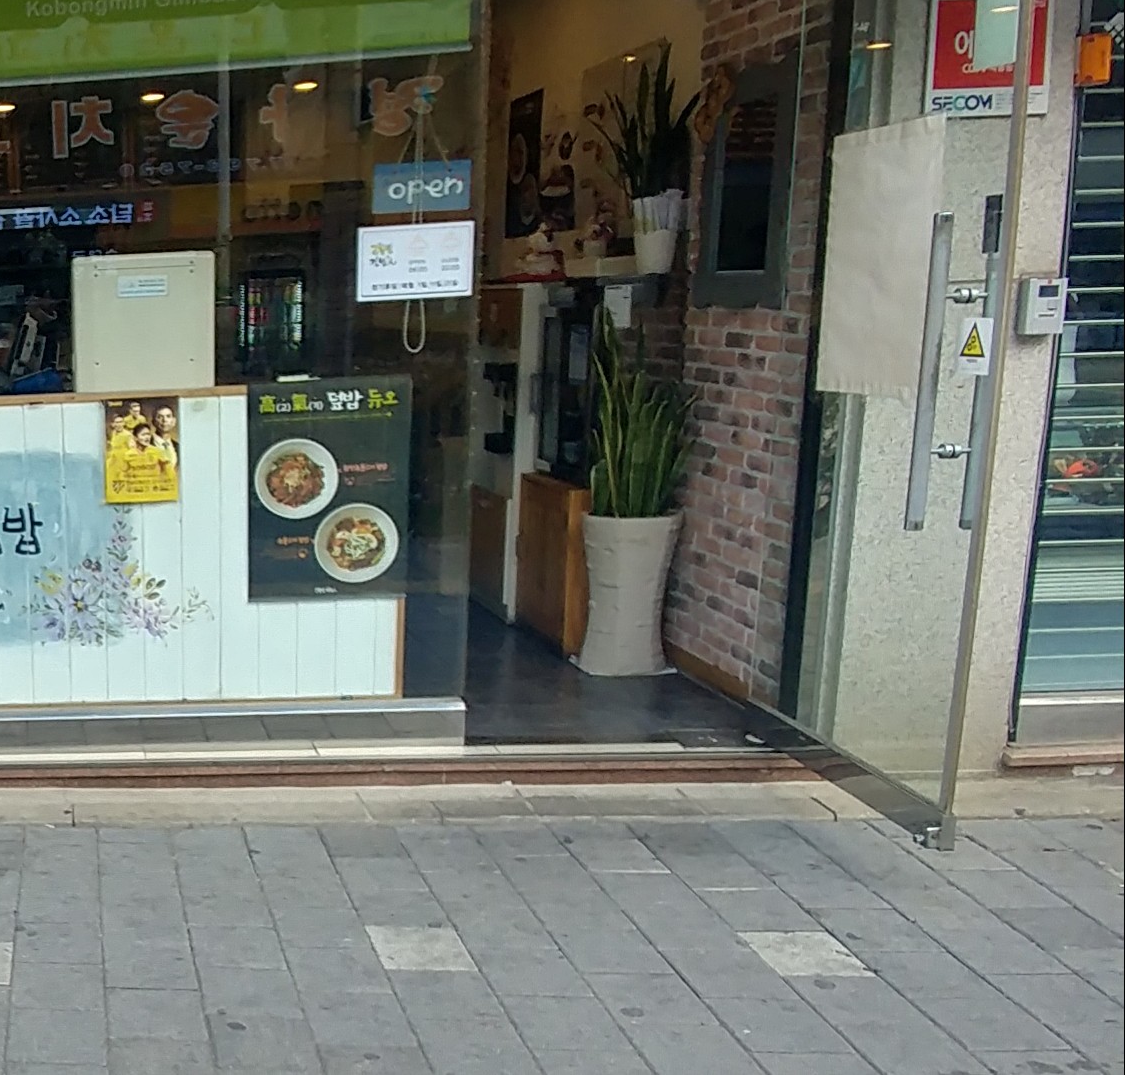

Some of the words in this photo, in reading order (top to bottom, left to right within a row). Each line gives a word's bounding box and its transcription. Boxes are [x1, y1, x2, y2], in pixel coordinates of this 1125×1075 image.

[931, 93, 994, 112] SECOM
[387, 176, 464, 205] open
[325, 387, 364, 411] 덮밥
[366, 387, 399, 410] 듀오
